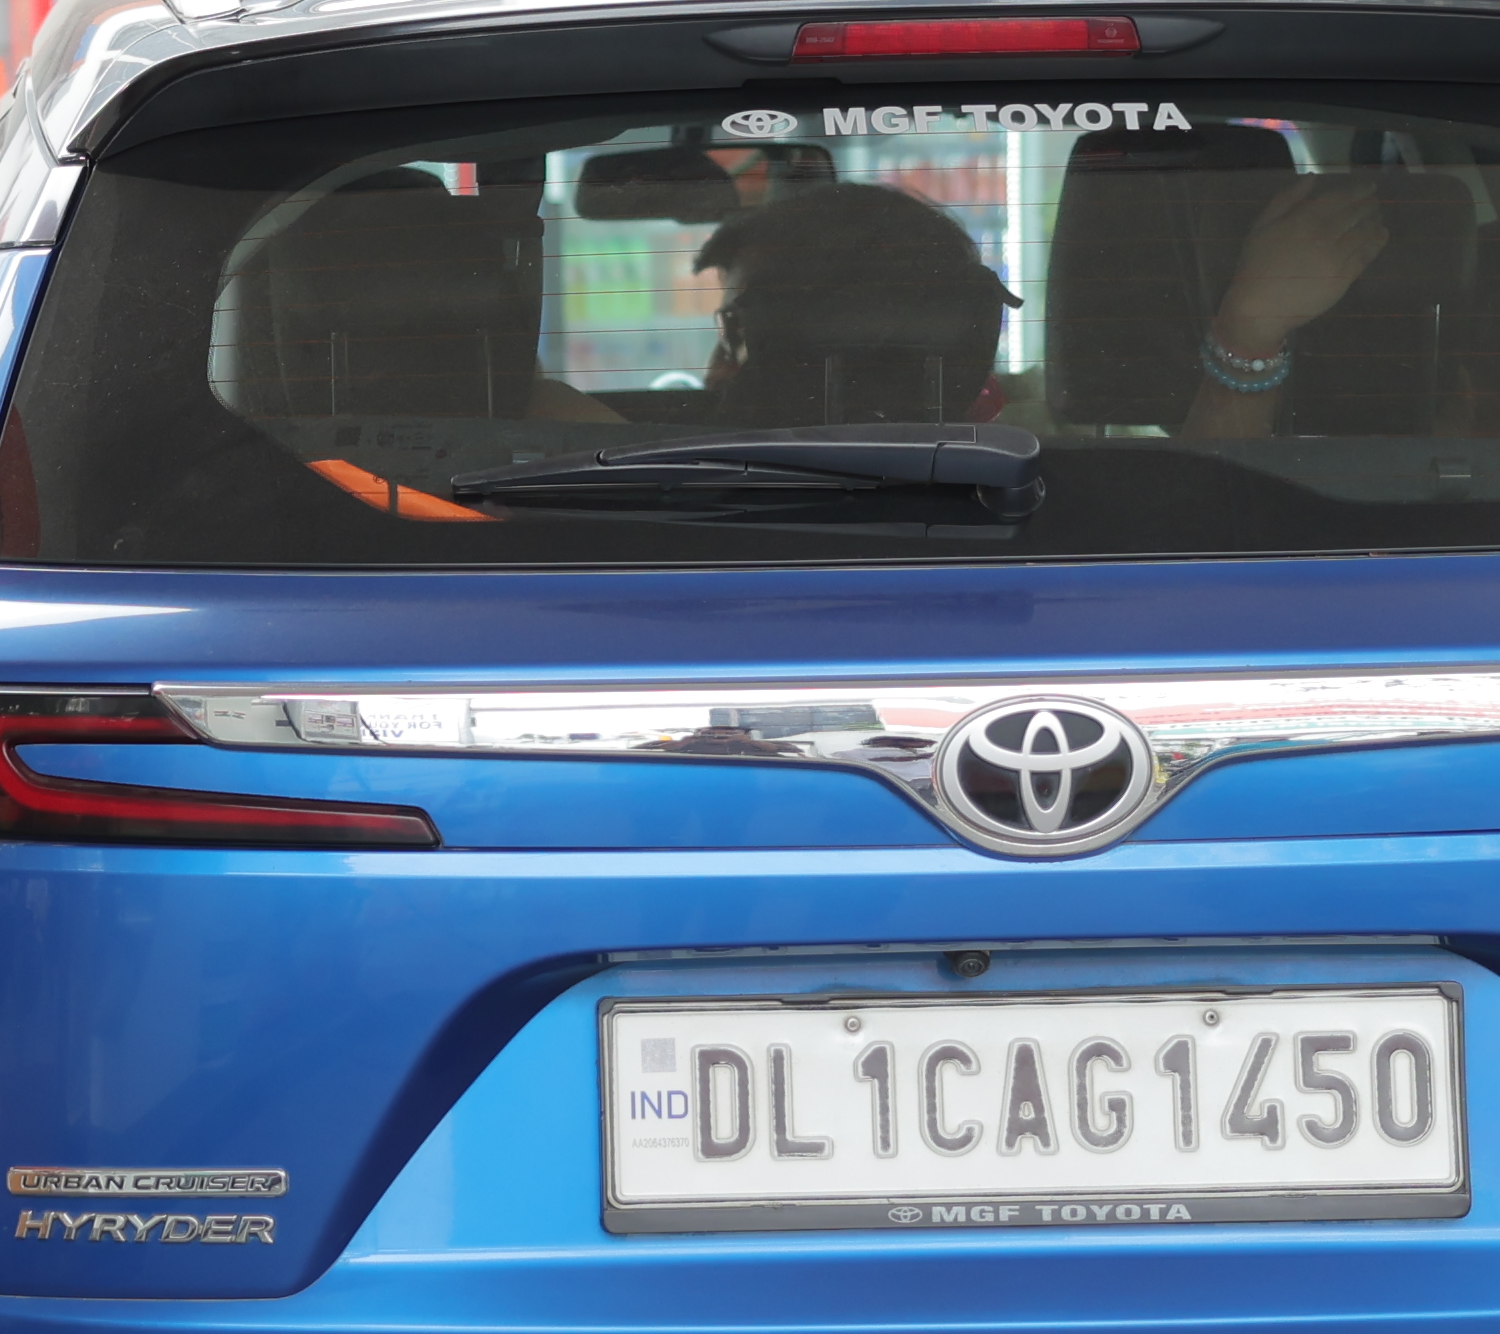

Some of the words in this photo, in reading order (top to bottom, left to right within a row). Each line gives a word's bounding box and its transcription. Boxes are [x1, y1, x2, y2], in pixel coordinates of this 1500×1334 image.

[822, 105, 942, 136] MGF
[961, 102, 1193, 131] TOYOTA
[630, 1090, 689, 1120] IND
[20, 1174, 126, 1190] URBAN
[132, 1174, 273, 1191] CRUISER
[14, 1210, 275, 1244] HYRYDER
[930, 1203, 1019, 1224] MGF
[1041, 1201, 1192, 1223] TOYOTA
